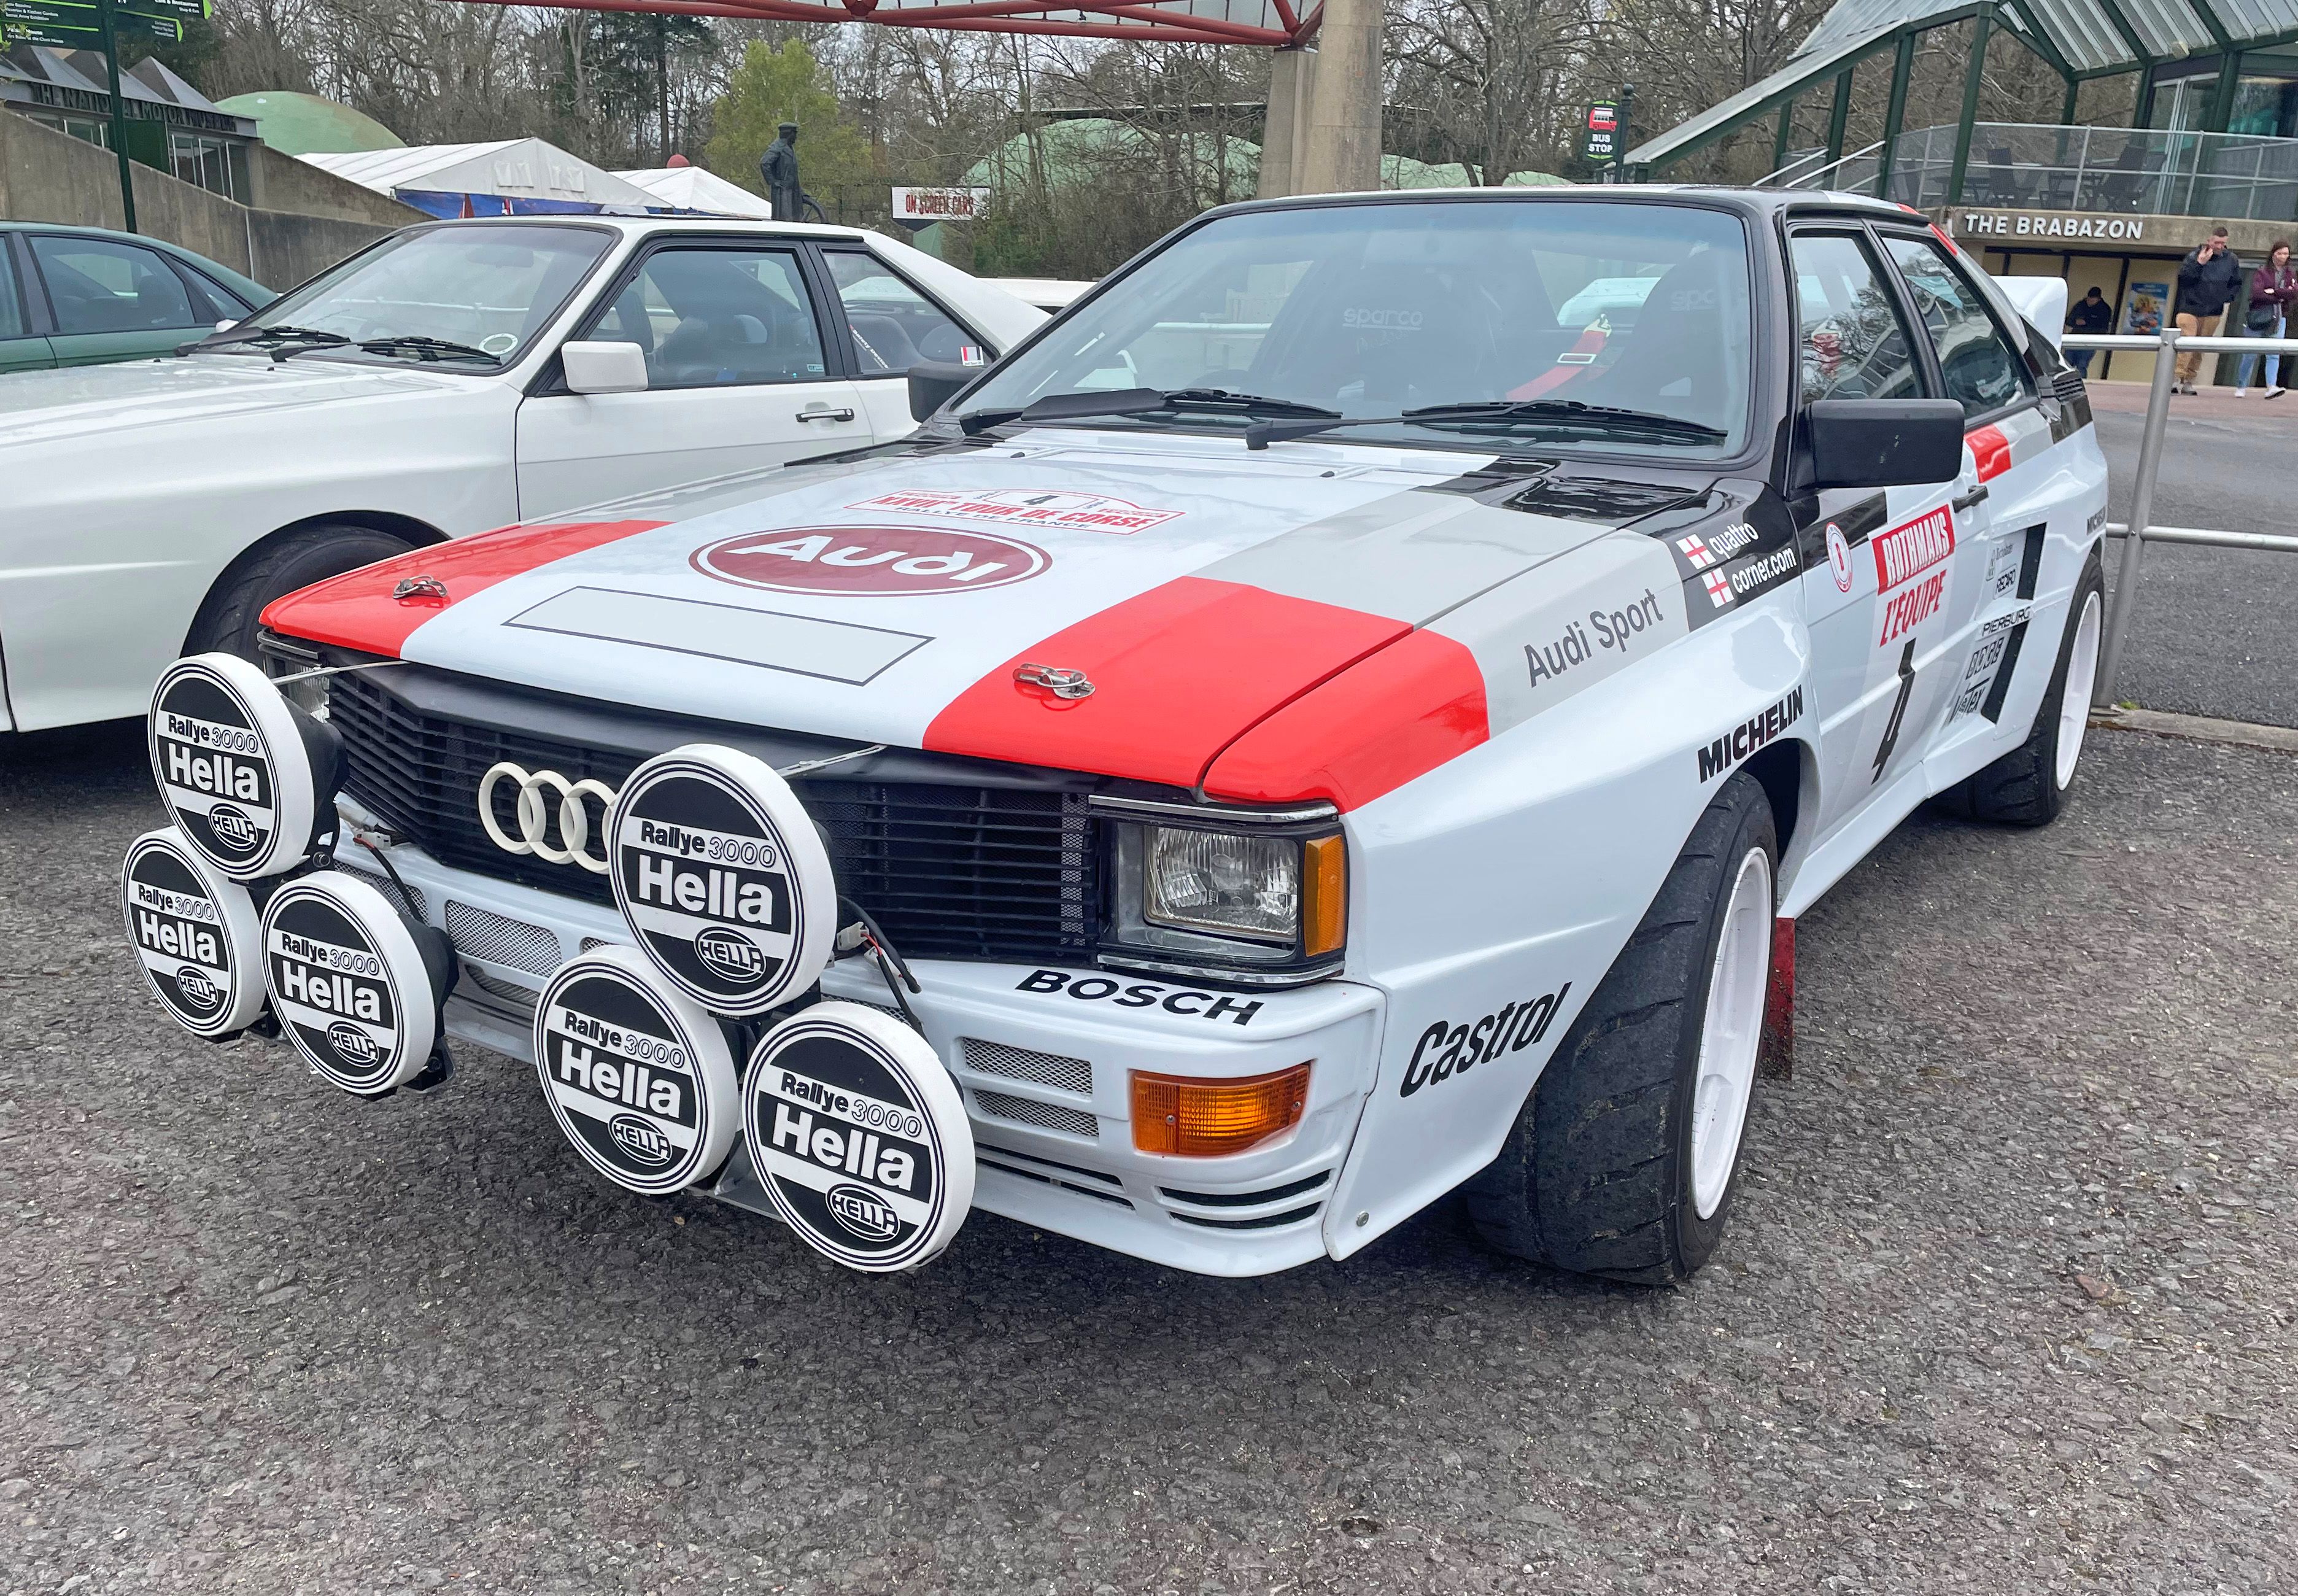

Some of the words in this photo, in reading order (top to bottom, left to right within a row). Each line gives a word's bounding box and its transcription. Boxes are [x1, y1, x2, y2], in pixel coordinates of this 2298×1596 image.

[65, 89, 139, 117] NATIOAL
[1588, 143, 1613, 153] STOP
[1592, 134, 1611, 142] BUS
[906, 195, 916, 213] ON
[953, 196, 973, 215] CARS
[1965, 213, 2008, 233] THE
[2016, 216, 2143, 239] BRABAZON
[1344, 308, 1424, 328] sparco
[894, 507, 969, 516] RALLYE
[1006, 517, 1091, 528] FRANCE
[948, 502, 1024, 516] TOUR
[1018, 509, 1064, 519] DE
[1058, 513, 1155, 527] CORSE
[1022, 495, 1059, 505] 4
[725, 535, 1008, 582] Audi
[1708, 522, 1759, 559] quattro
[1882, 511, 1951, 587] ROTHMANS
[1731, 548, 1797, 594] corner.com
[1524, 621, 1592, 688] Audi
[1590, 588, 1664, 653] Sport
[1982, 606, 2031, 637] PIERBURG
[1871, 637, 1916, 786] 4
[169, 715, 209, 742] Rallye
[211, 727, 258, 753] 3000
[1698, 684, 1803, 784] MICHELIN
[169, 742, 259, 802] Hella
[212, 814, 258, 843] HELLA
[641, 821, 705, 855] Rallye
[708, 836, 776, 868] 3000
[138, 885, 173, 910] Rallye
[175, 897, 214, 920] 3000
[638, 854, 773, 925] Hella
[139, 910, 218, 965] Hella
[282, 933, 327, 963] Rallye
[330, 948, 379, 975] 3000
[700, 940, 765, 972] HELLA
[179, 975, 218, 1002] HELLA
[283, 960, 381, 1022] Hella
[1015, 969, 1264, 1026] BOSCH
[330, 1030, 379, 1061] HELLA
[565, 1011, 622, 1048] Rallye
[624, 1034, 686, 1069] 3000
[1400, 981, 1573, 1098] Castrol
[560, 1040, 680, 1119] Hella
[781, 1071, 849, 1112] Rallye
[851, 1098, 923, 1138] 3000
[614, 1127, 671, 1161] HELLA
[772, 1102, 915, 1191] Hella
[832, 1193, 898, 1234] HELLA
